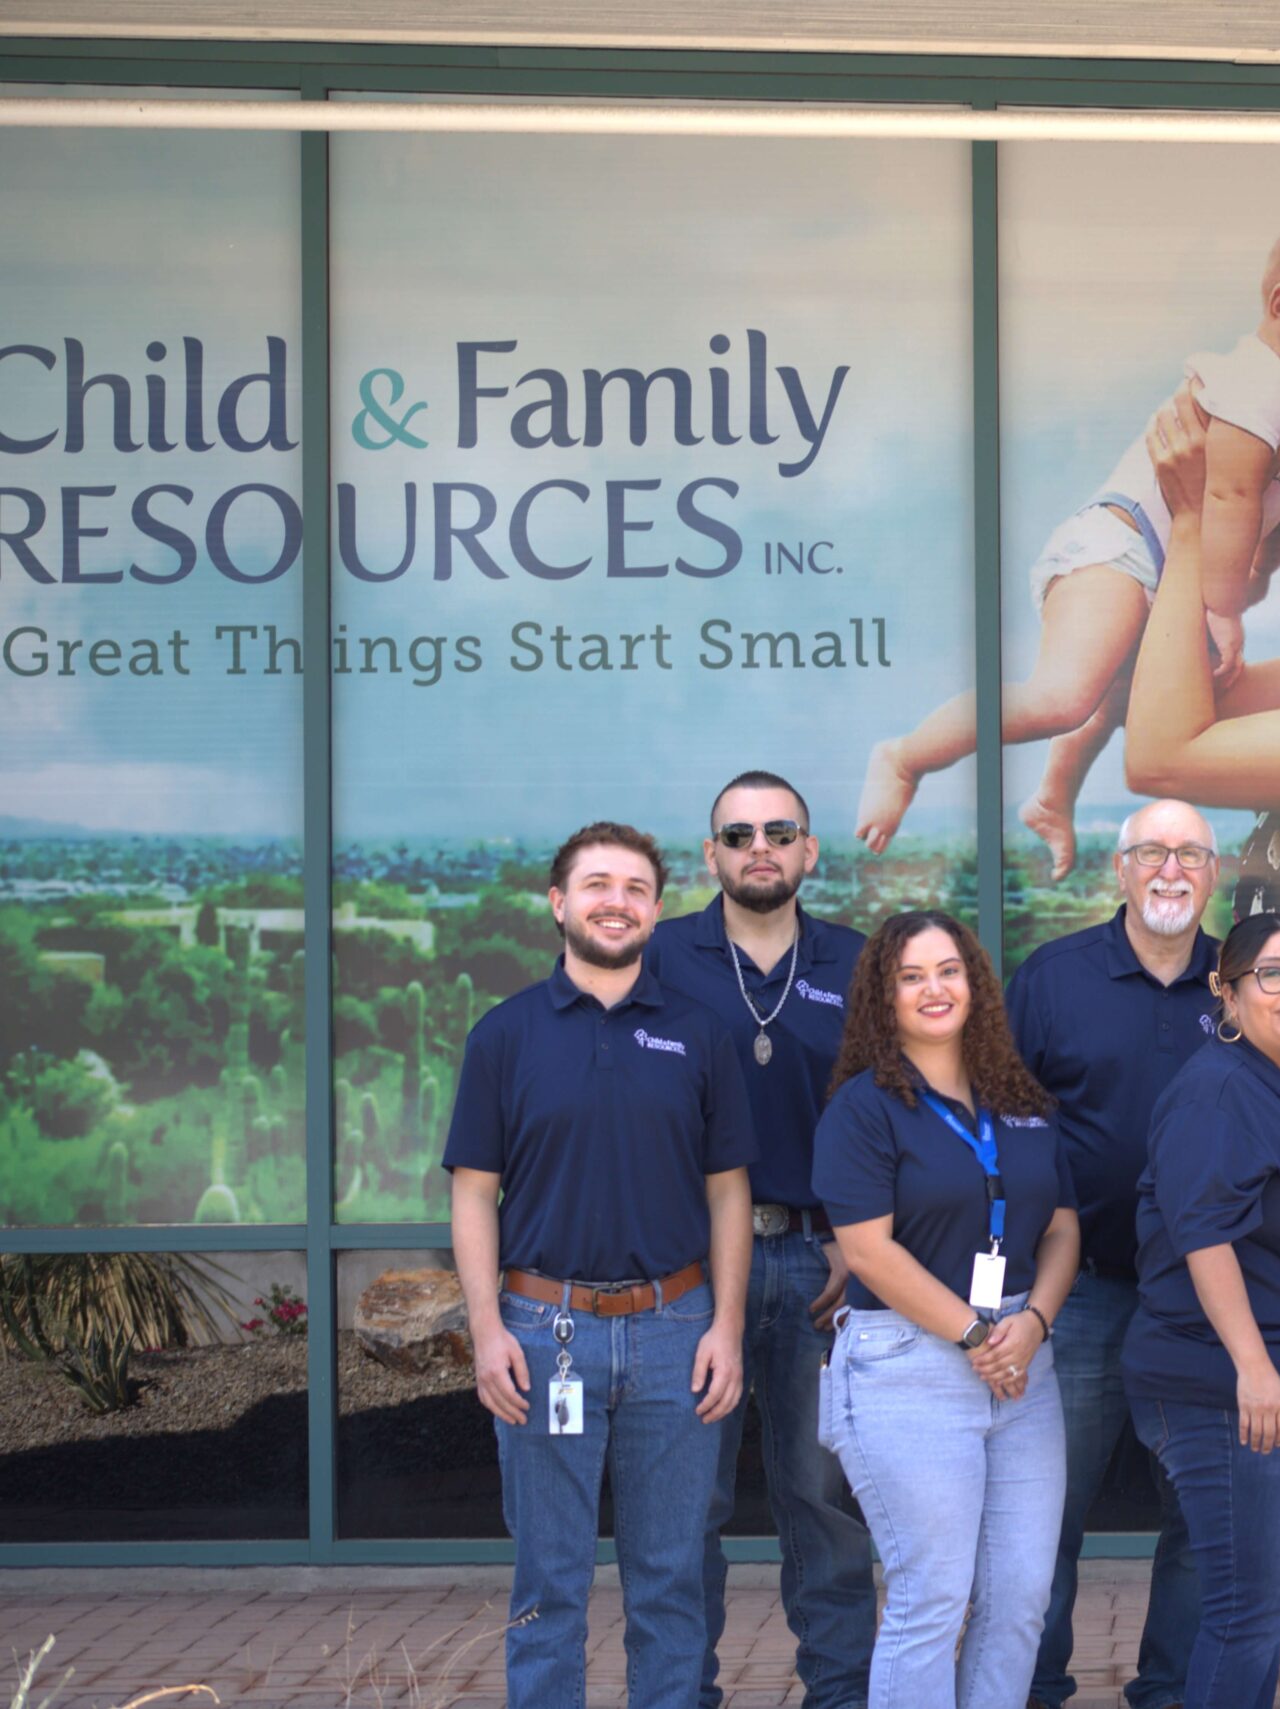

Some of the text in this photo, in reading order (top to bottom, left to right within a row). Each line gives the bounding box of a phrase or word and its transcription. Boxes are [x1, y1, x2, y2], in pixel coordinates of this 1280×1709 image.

[0, 329, 851, 477] Child & Family
[0, 477, 844, 585] RESOURCES INC.
[2, 617, 891, 687] Great Things Start Small
